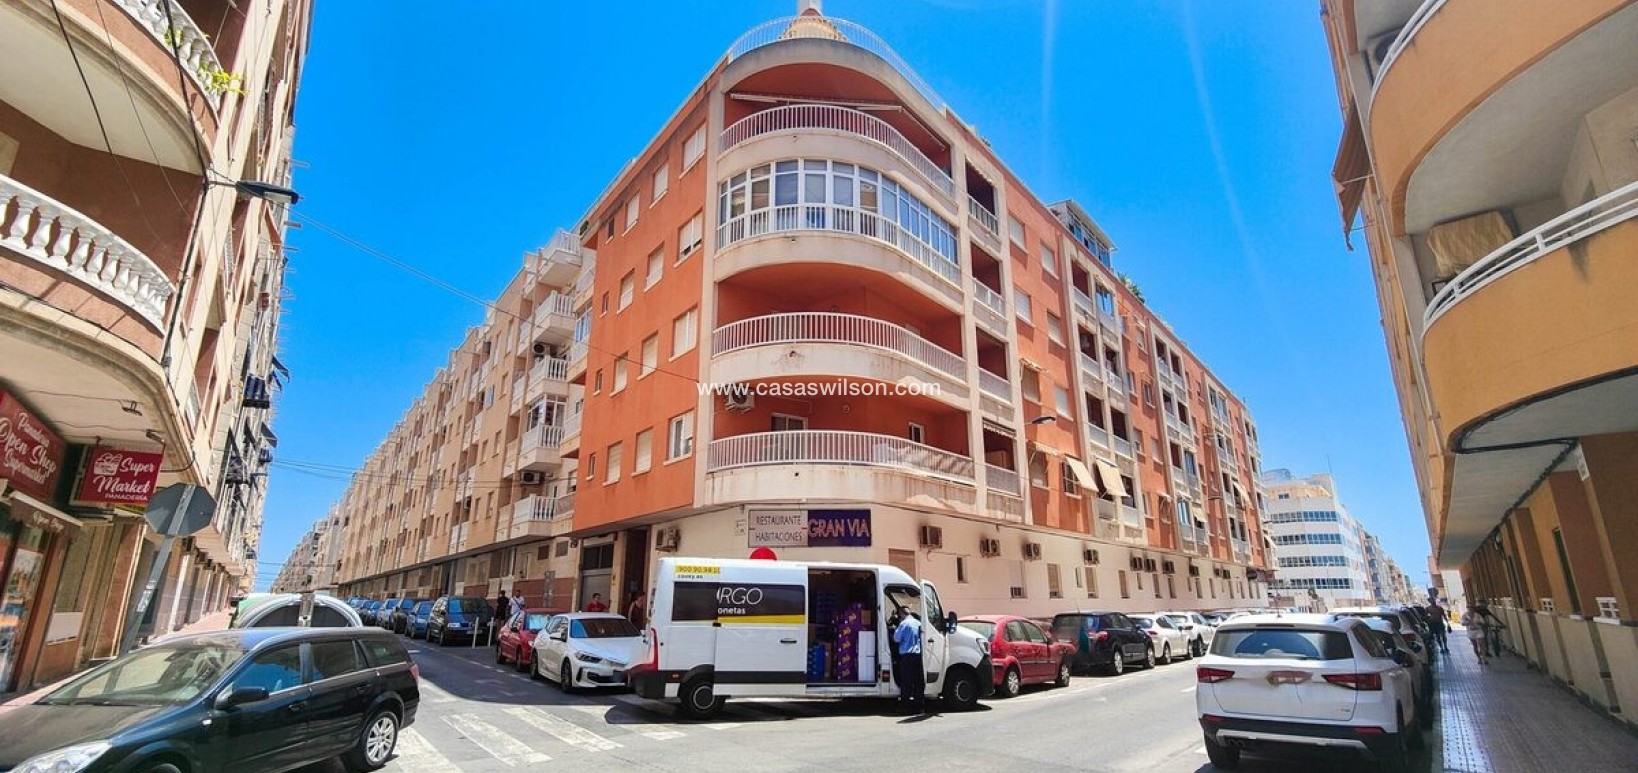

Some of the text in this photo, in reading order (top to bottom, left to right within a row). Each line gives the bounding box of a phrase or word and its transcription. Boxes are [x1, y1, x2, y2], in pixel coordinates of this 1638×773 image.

[0, 416, 57, 478] Open Shop
[120, 457, 155, 477] Super
[93, 475, 151, 493] Market
[755, 515, 802, 526] RESTAURANTE
[808, 518, 870, 538] GRAN VIA
[755, 531, 803, 543] HABITACIONES
